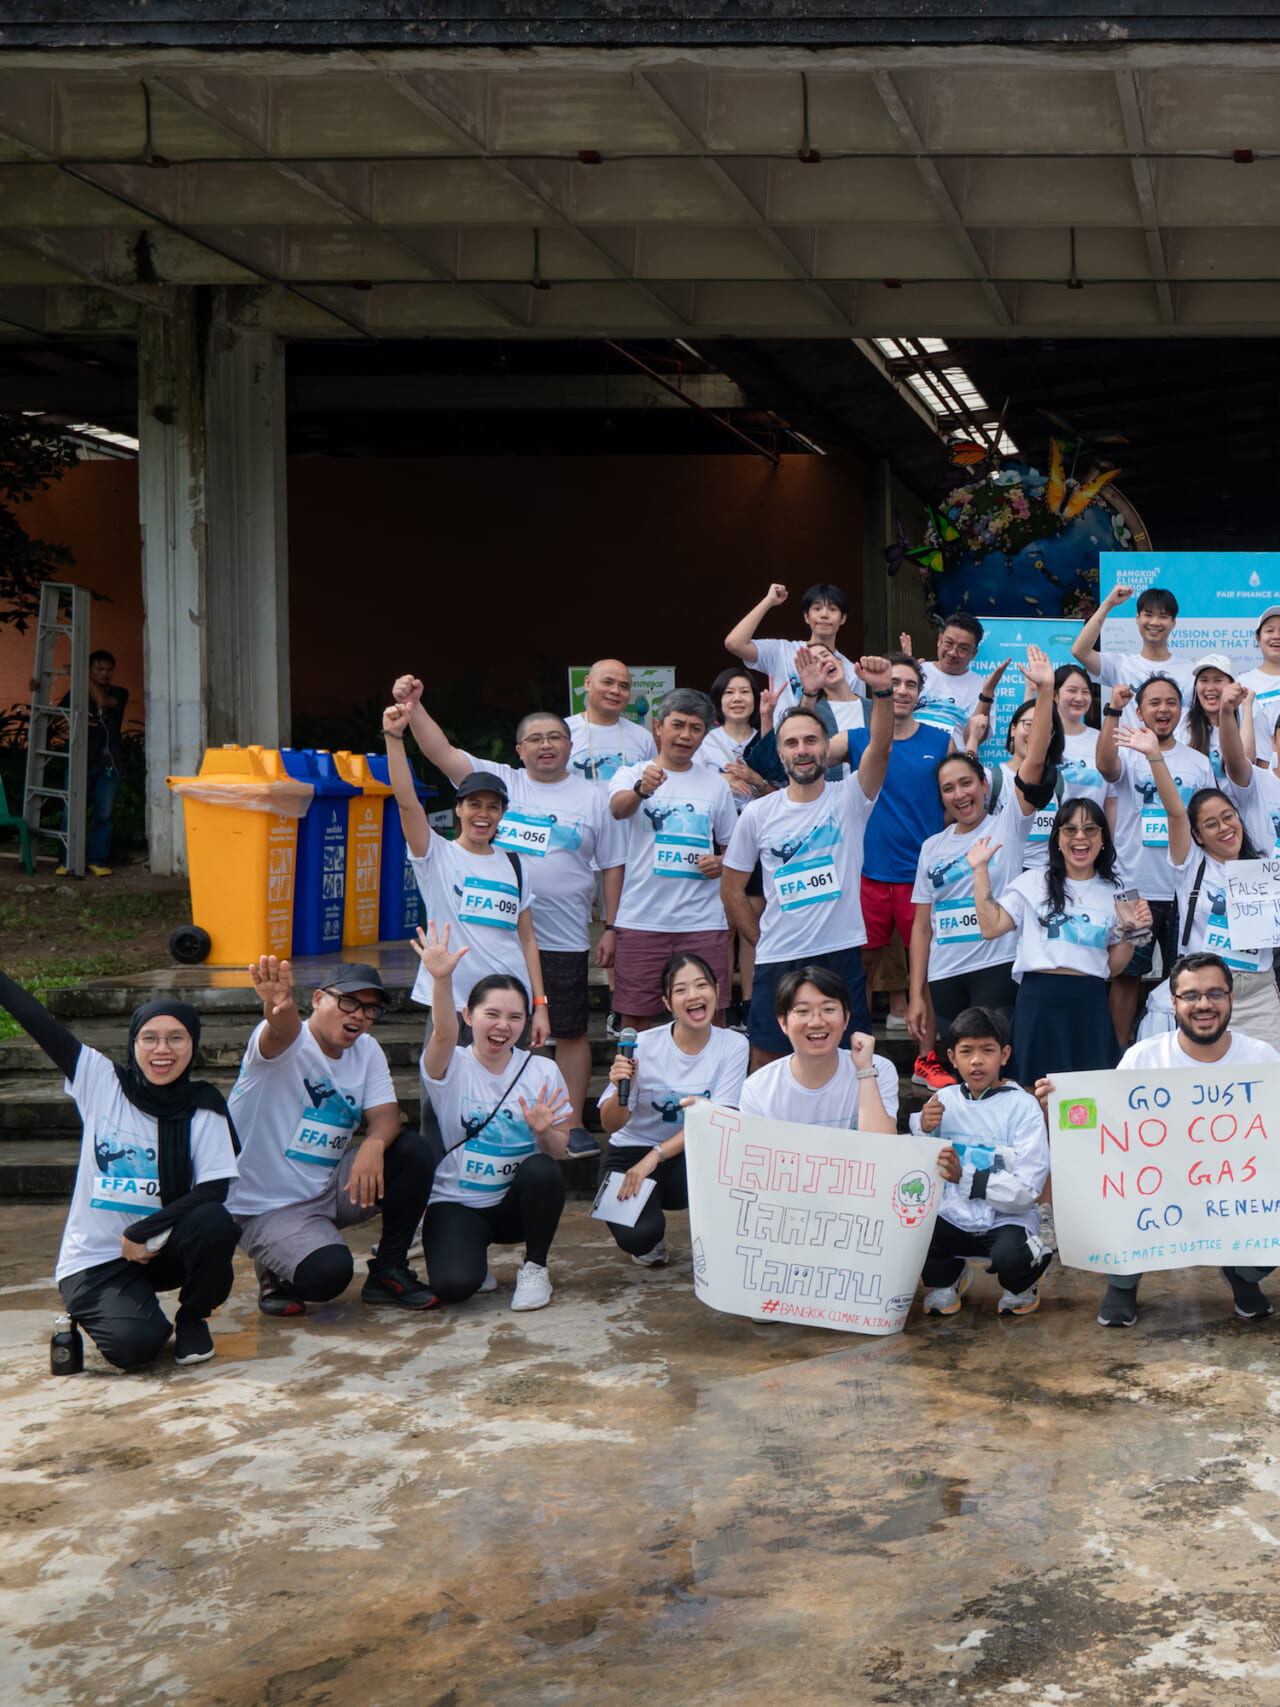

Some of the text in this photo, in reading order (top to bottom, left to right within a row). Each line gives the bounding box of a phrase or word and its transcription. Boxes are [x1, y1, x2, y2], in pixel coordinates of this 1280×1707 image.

[1167, 640, 1216, 648] ANSITION
[1221, 640, 1246, 648] THAT
[1171, 630, 1209, 638] VISION
[1213, 630, 1229, 638] OF
[499, 825, 546, 844] FA-056
[658, 850, 700, 865] FFA-05
[1262, 861, 1280, 873] NO
[779, 873, 833, 897] FFA-061
[1228, 876, 1269, 898] FALSE
[466, 895, 517, 915] FFA-099
[1232, 900, 1265, 920] JUST
[939, 913, 978, 930] FFA-06
[1128, 1080, 1264, 1111] GO JUST
[1100, 1118, 1168, 1155] NO
[466, 1160, 521, 1177] FFA-02
[1102, 1156, 1256, 1199] NO GAS
[1136, 1204, 1183, 1231] GO
